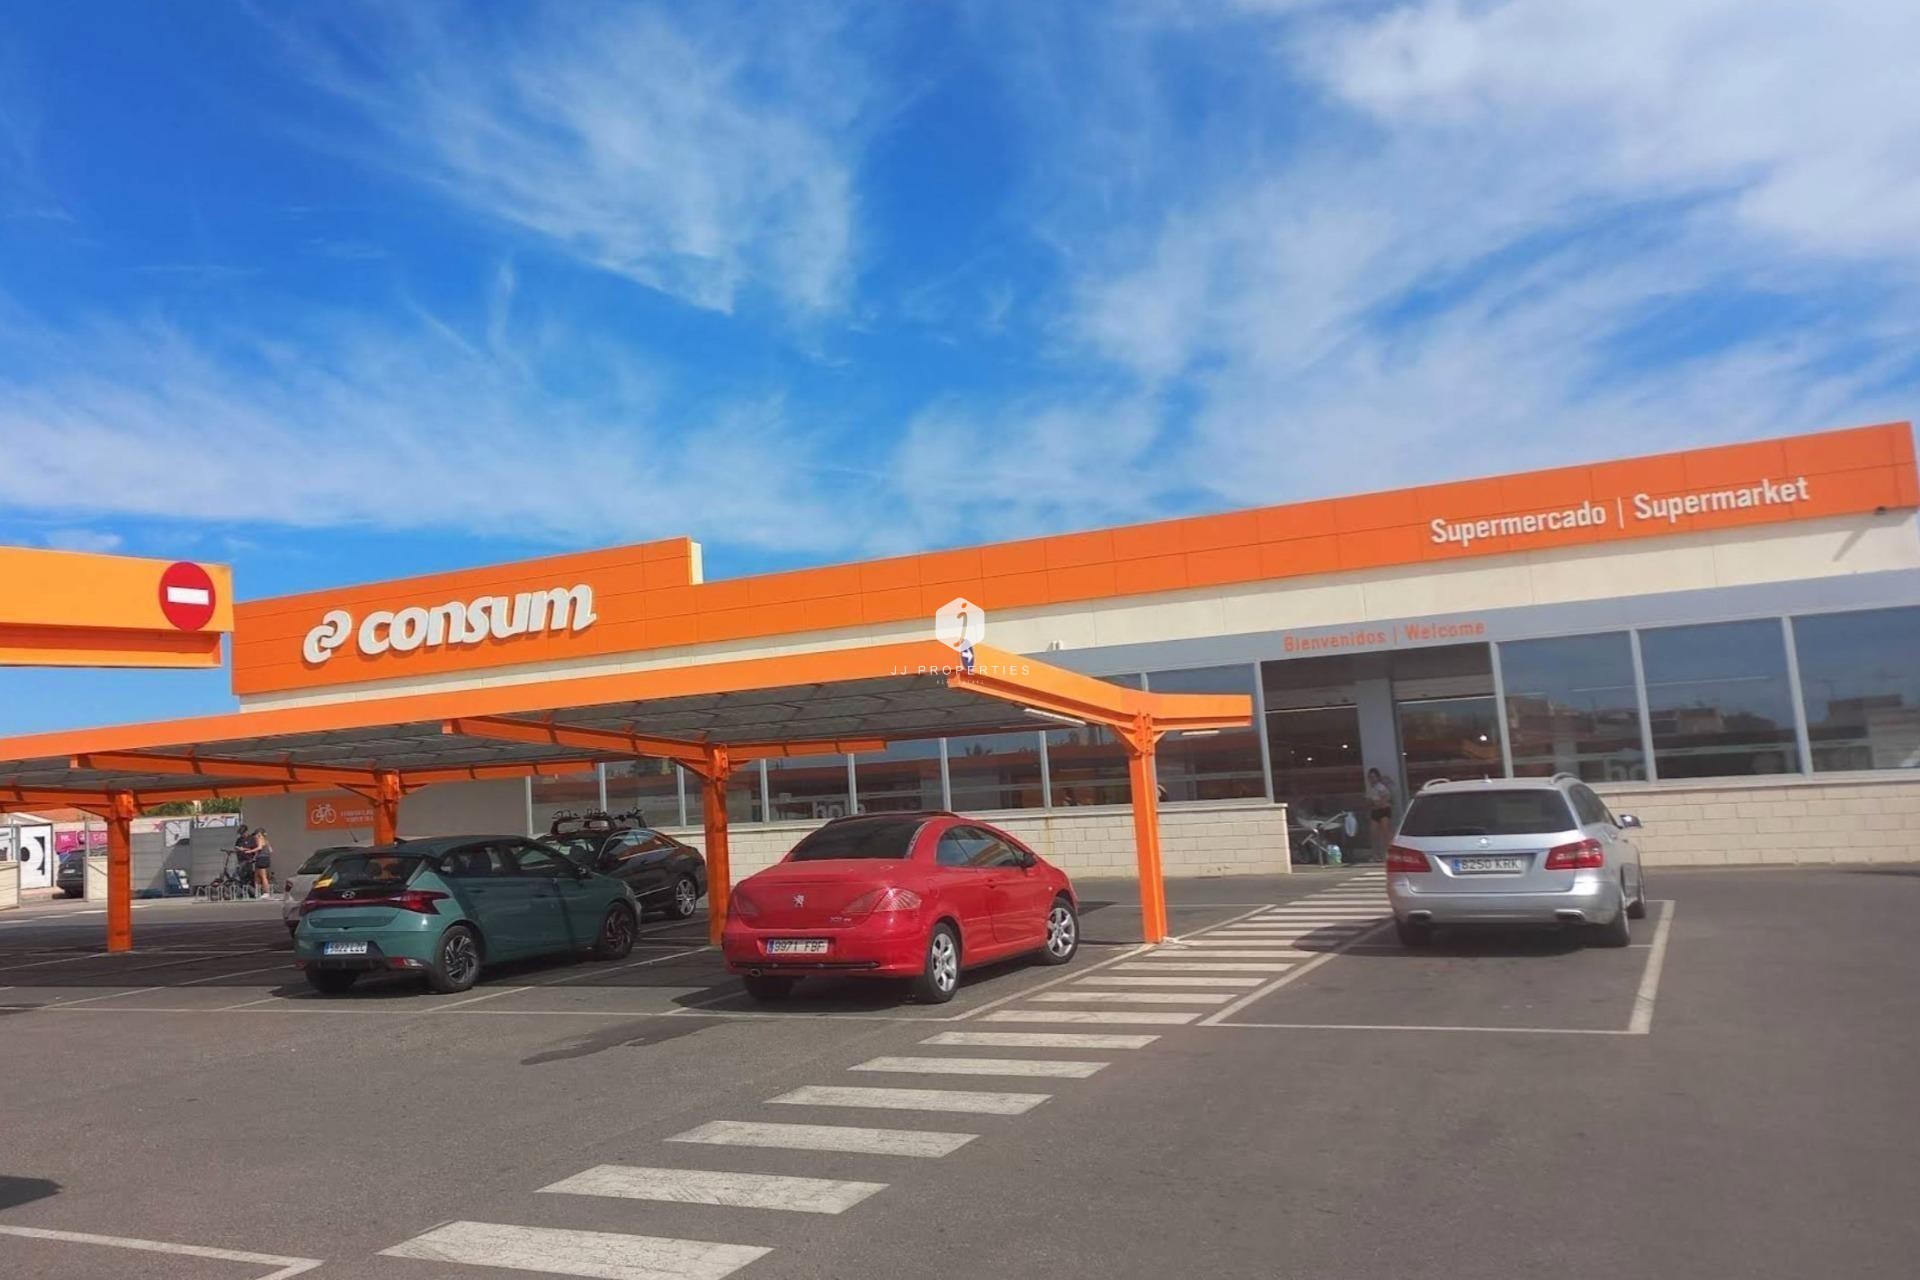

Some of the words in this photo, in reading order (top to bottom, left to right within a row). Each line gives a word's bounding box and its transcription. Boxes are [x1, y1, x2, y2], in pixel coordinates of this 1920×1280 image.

[1431, 500, 1607, 547] Supermercado
[1633, 476, 1809, 523] Supermarket
[358, 584, 597, 655] consum
[1283, 630, 1386, 652] Bienvenidos
[1404, 621, 1485, 641] Welcome
